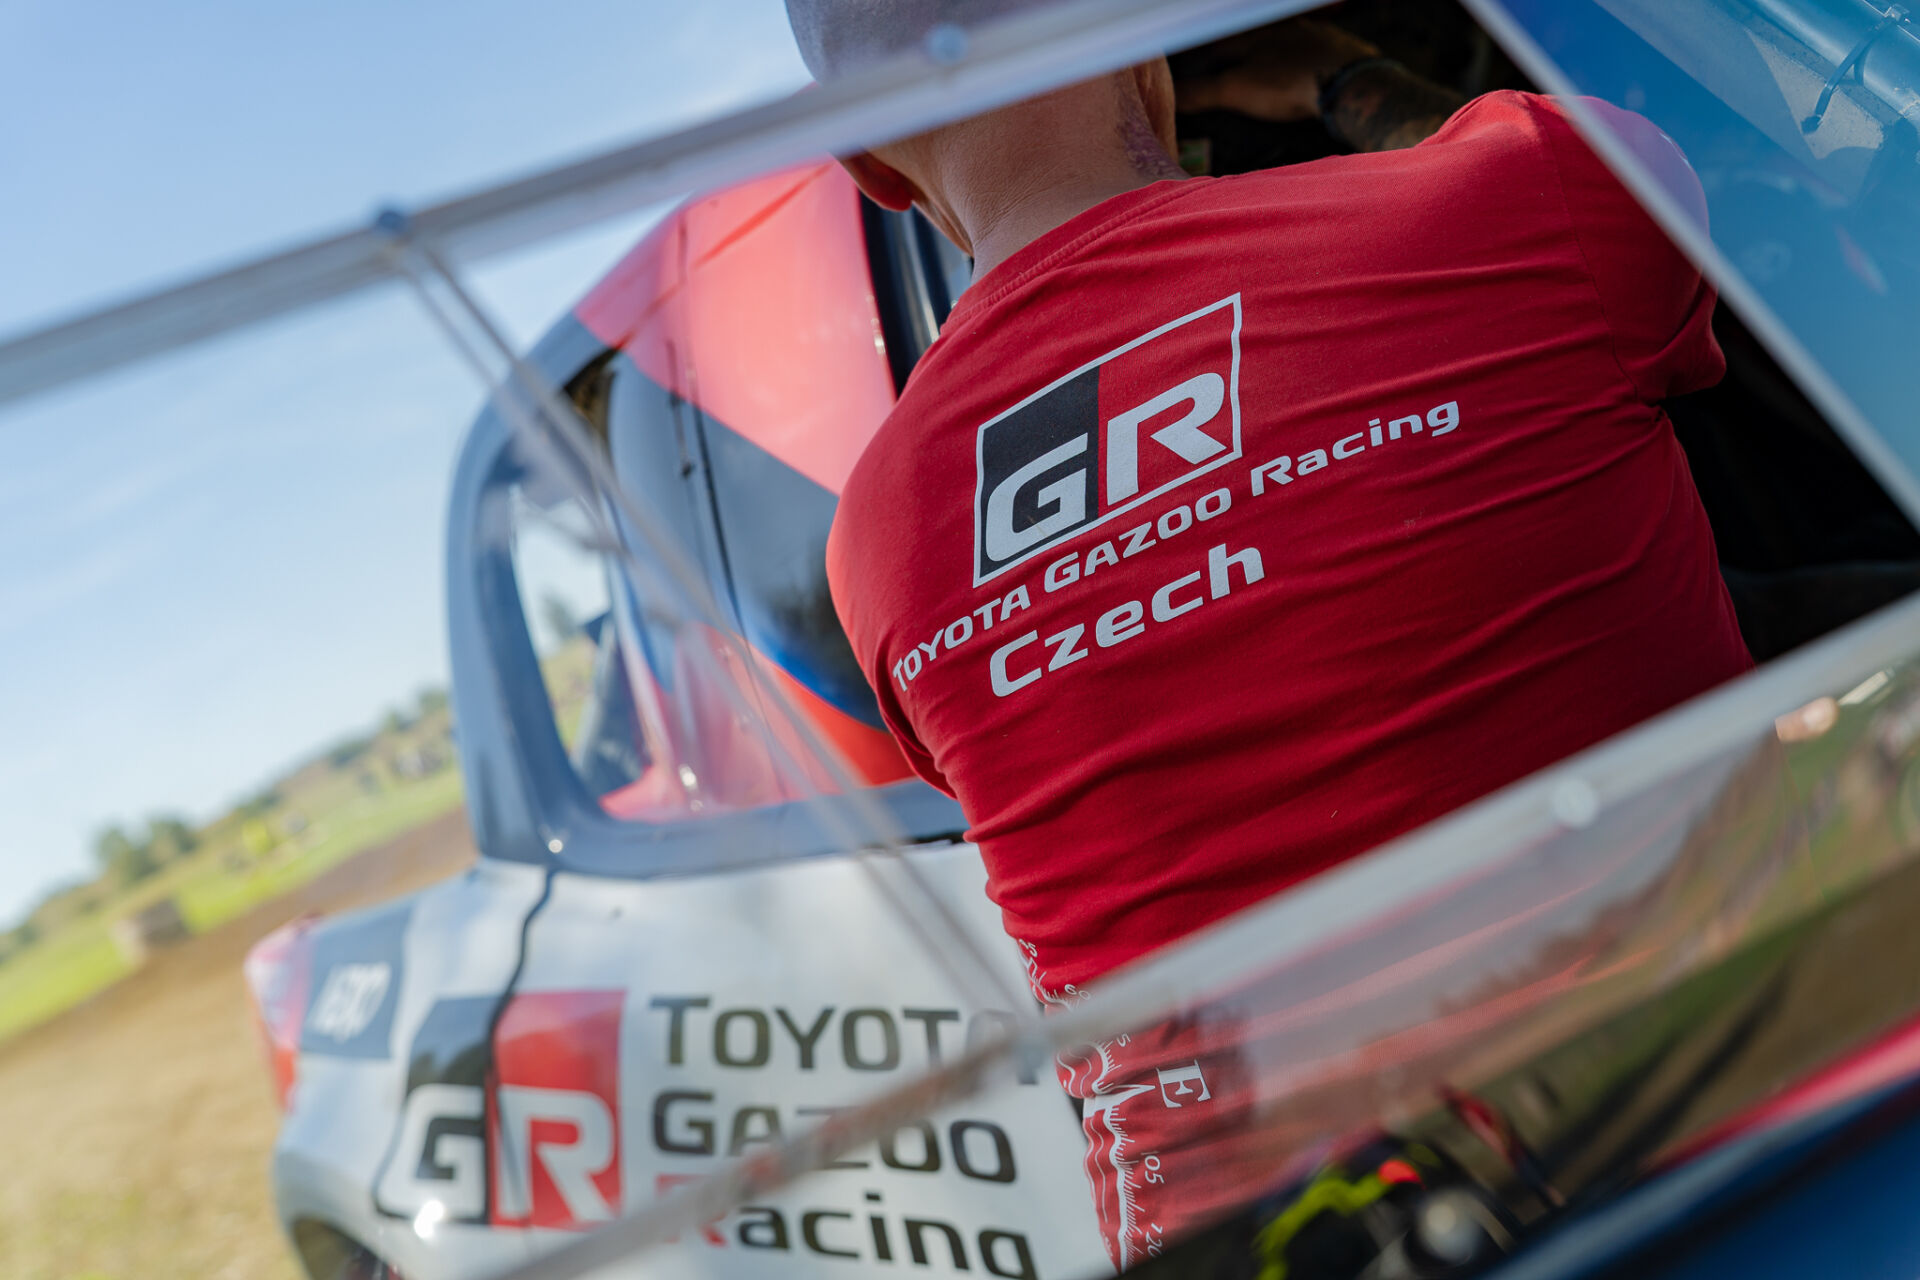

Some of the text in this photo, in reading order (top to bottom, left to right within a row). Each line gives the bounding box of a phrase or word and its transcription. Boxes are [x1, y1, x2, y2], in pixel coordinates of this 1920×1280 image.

[986, 372, 1226, 562] GR
[892, 401, 1460, 692] TOYOTA GAZOO Racing
[989, 543, 1266, 698] Czech
[378, 1082, 620, 1222] GR
[1156, 1059, 1211, 1108] E
[655, 1174, 1040, 1280] acing
